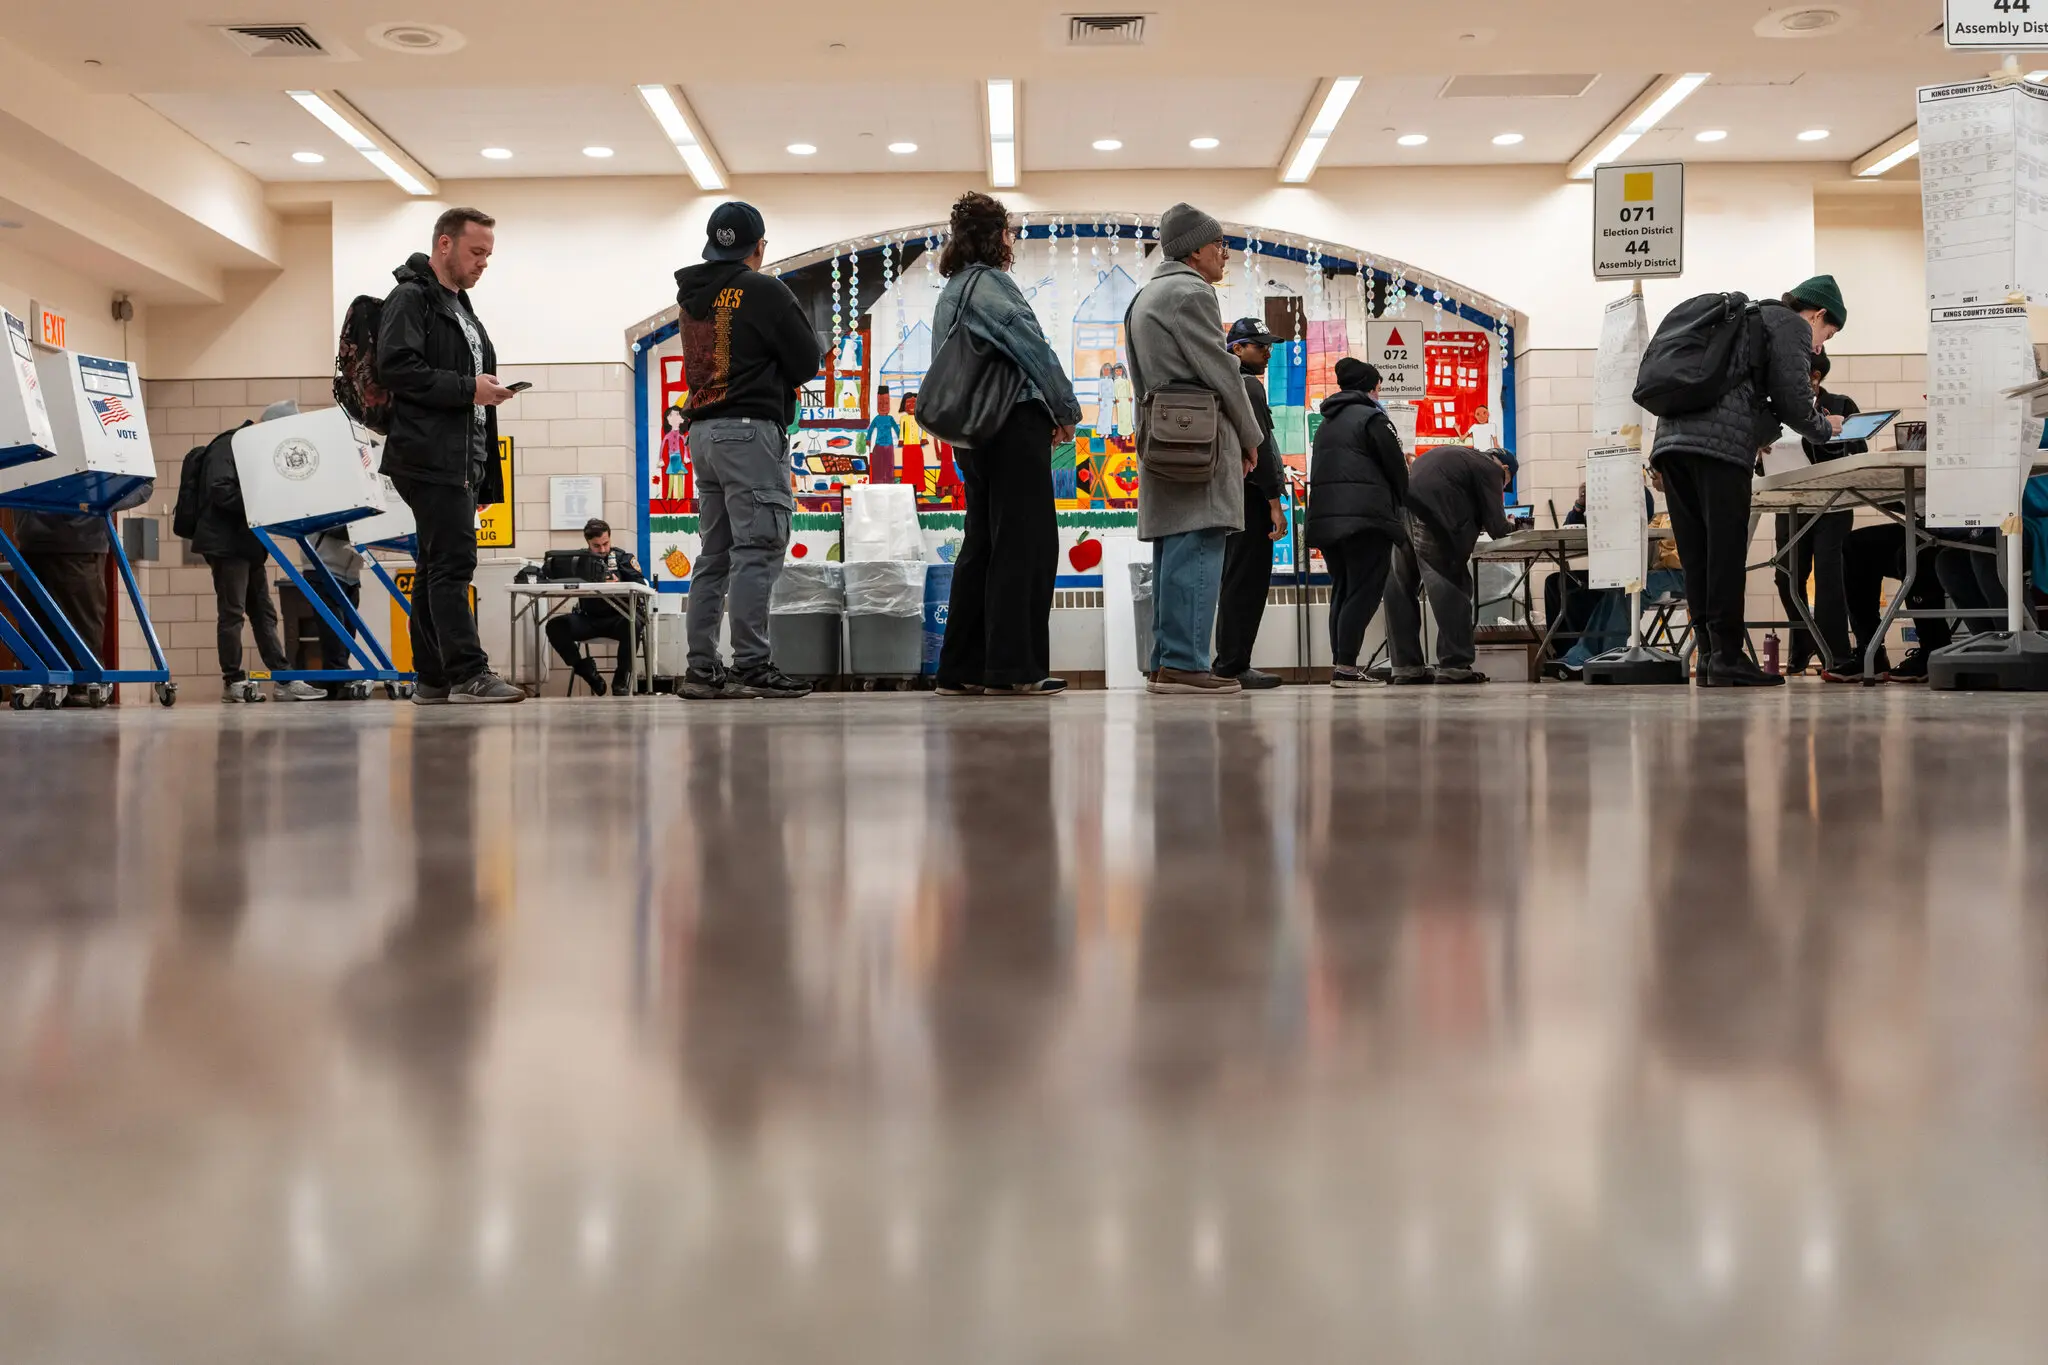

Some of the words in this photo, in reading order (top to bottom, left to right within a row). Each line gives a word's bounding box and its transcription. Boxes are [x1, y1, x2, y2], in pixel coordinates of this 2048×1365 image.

[1955, 21, 2019, 36] Assembly
[1931, 89, 1950, 98] KINGS
[1951, 86, 1975, 95] COUNTY
[1620, 207, 1655, 222] 071
[1603, 228, 1639, 236] Election
[1641, 226, 1674, 235] District
[1625, 240, 1650, 254] 44
[1599, 260, 1642, 270] Assembly
[1644, 258, 1677, 267] District
[1943, 310, 1961, 318] KINGS
[1963, 309, 1987, 317] COUNTY
[1988, 307, 2005, 315] 2025
[44, 311, 66, 348] EXIT
[1384, 350, 1408, 360] 072
[1388, 373, 1404, 382] 44
[800, 407, 834, 420] FISH
[117, 429, 137, 440] VOTE
[480, 519, 494, 528] OT
